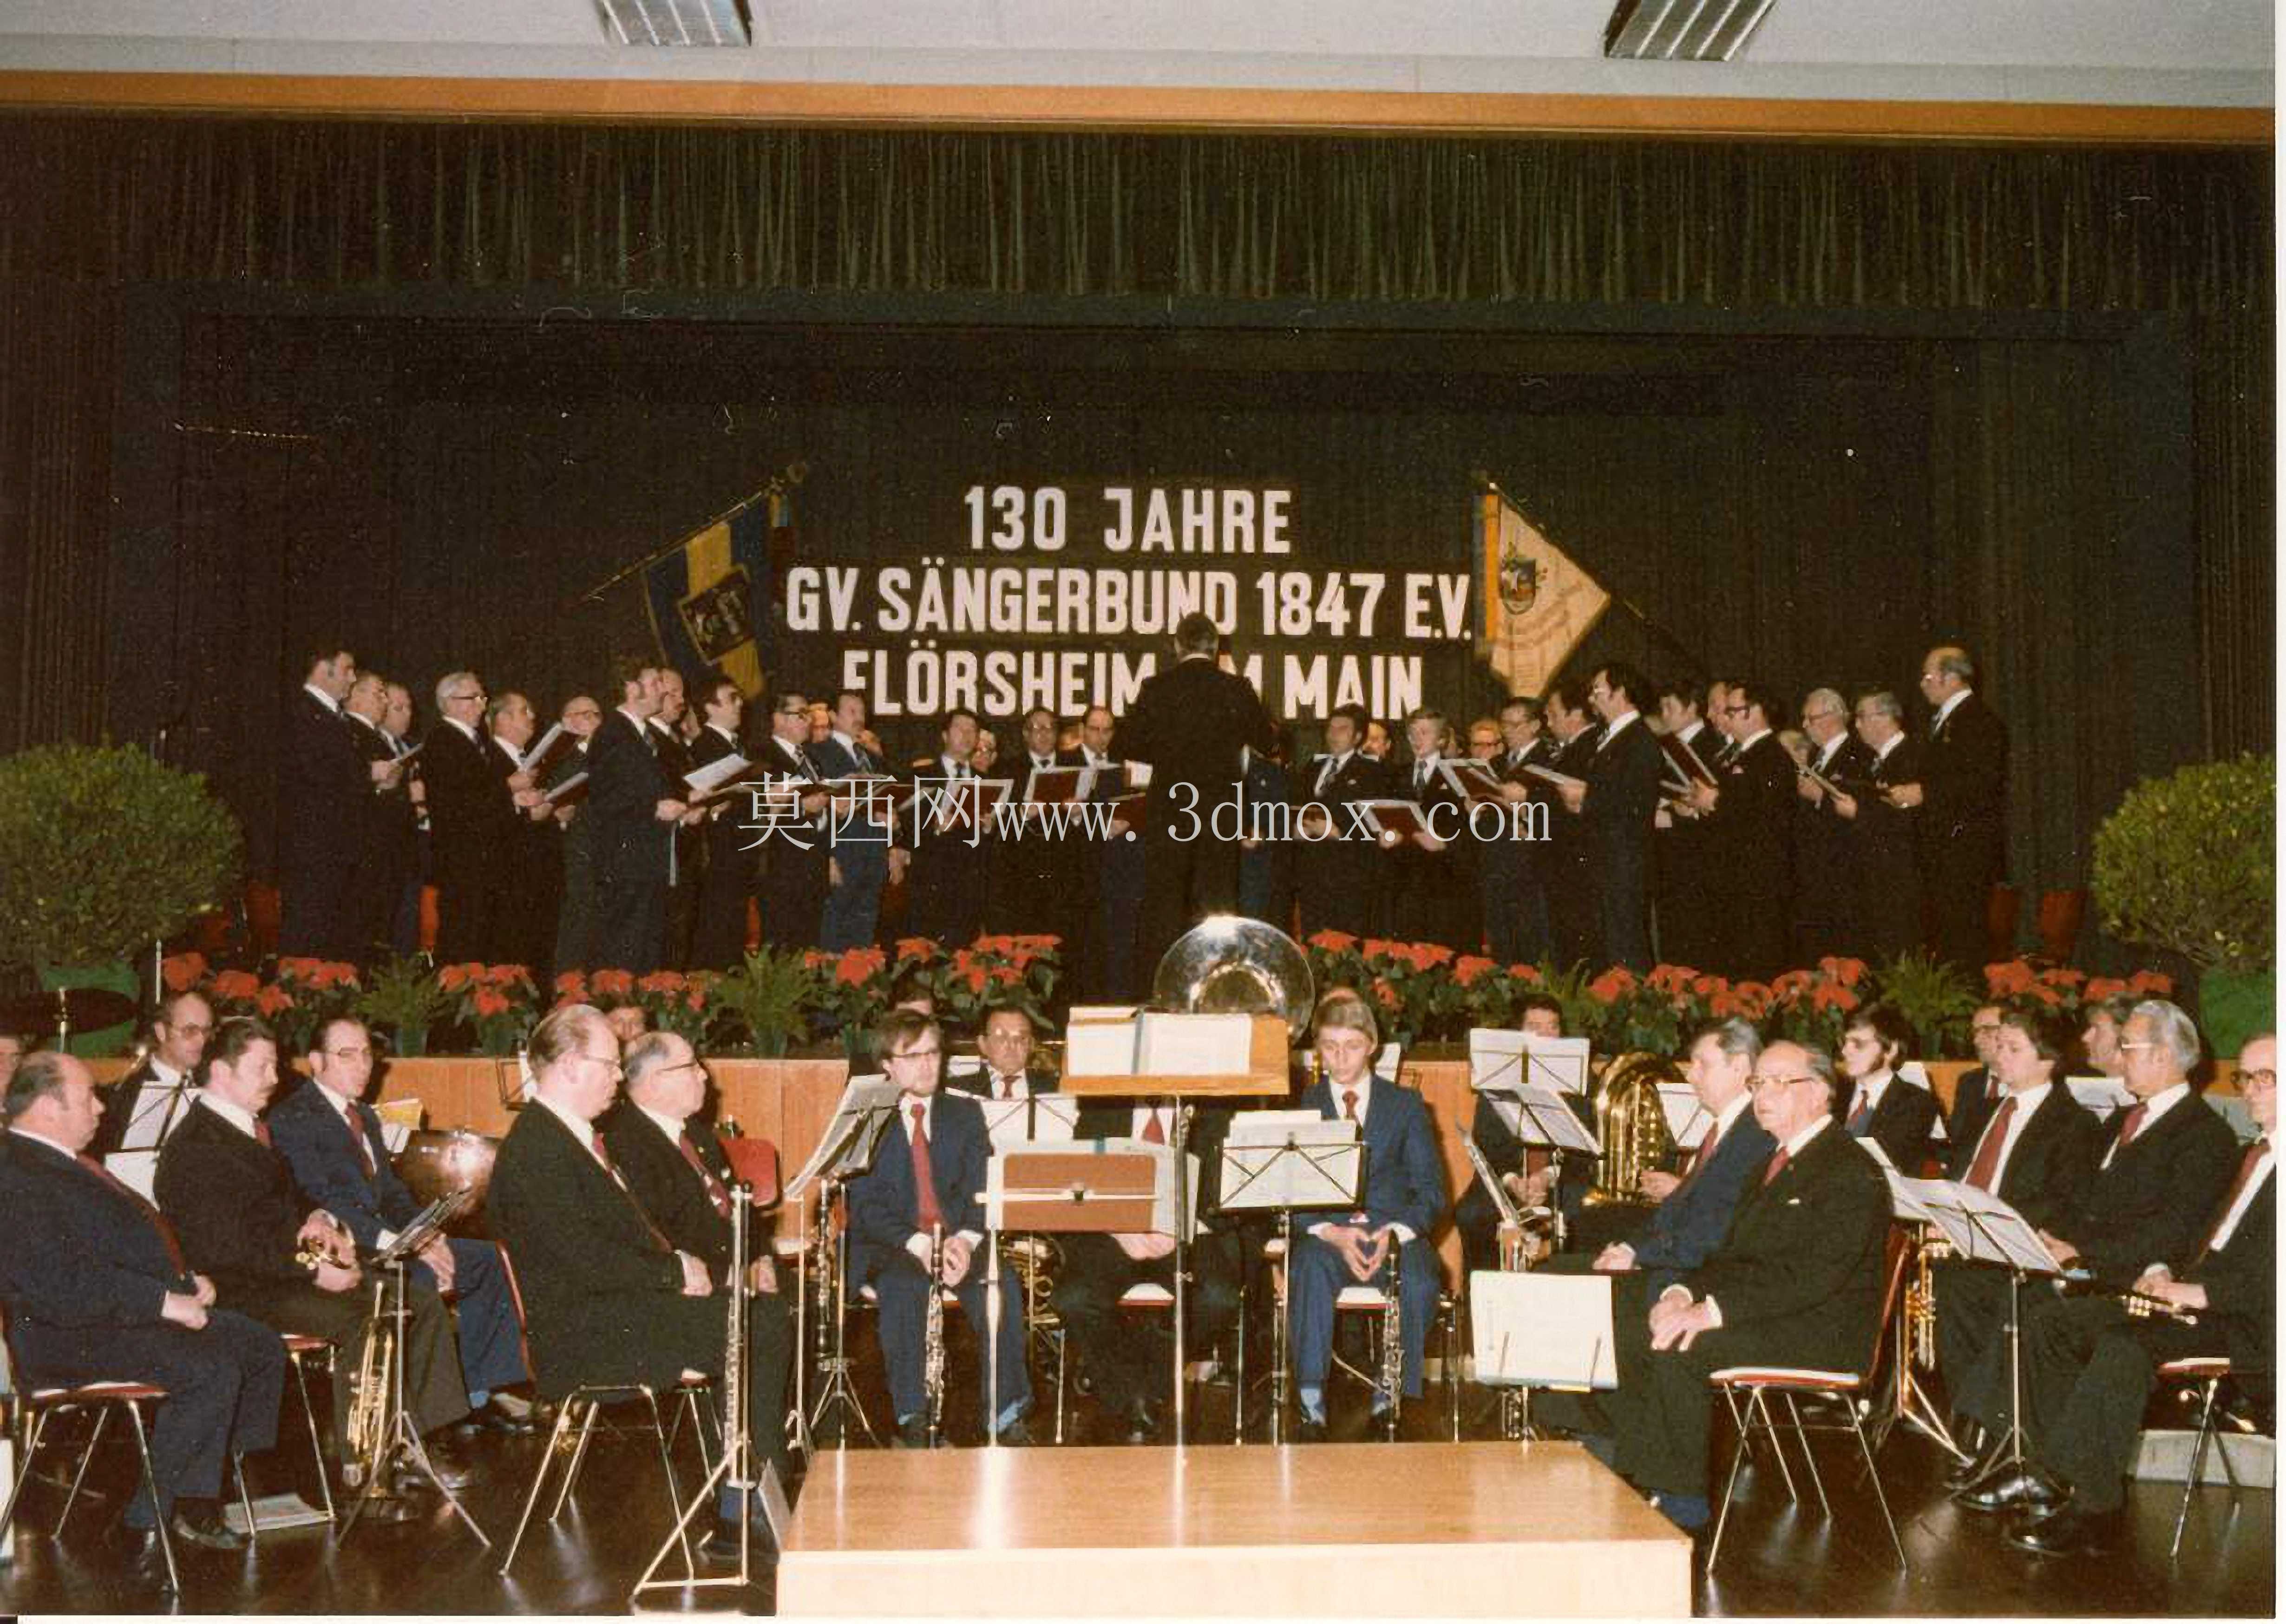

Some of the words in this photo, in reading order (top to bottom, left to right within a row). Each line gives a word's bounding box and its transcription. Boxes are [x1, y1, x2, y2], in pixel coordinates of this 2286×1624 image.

[964, 485, 1066, 552] 130
[1104, 487, 1291, 553] JAHRE
[786, 566, 861, 633] GV.
[878, 557, 1237, 635] SÄNGERBUND
[1256, 571, 1386, 637] 1847
[1405, 572, 1472, 640] E.V.
[844, 639, 1156, 717] FLÖRSHEIM
[1284, 654, 1422, 720] MAIN
